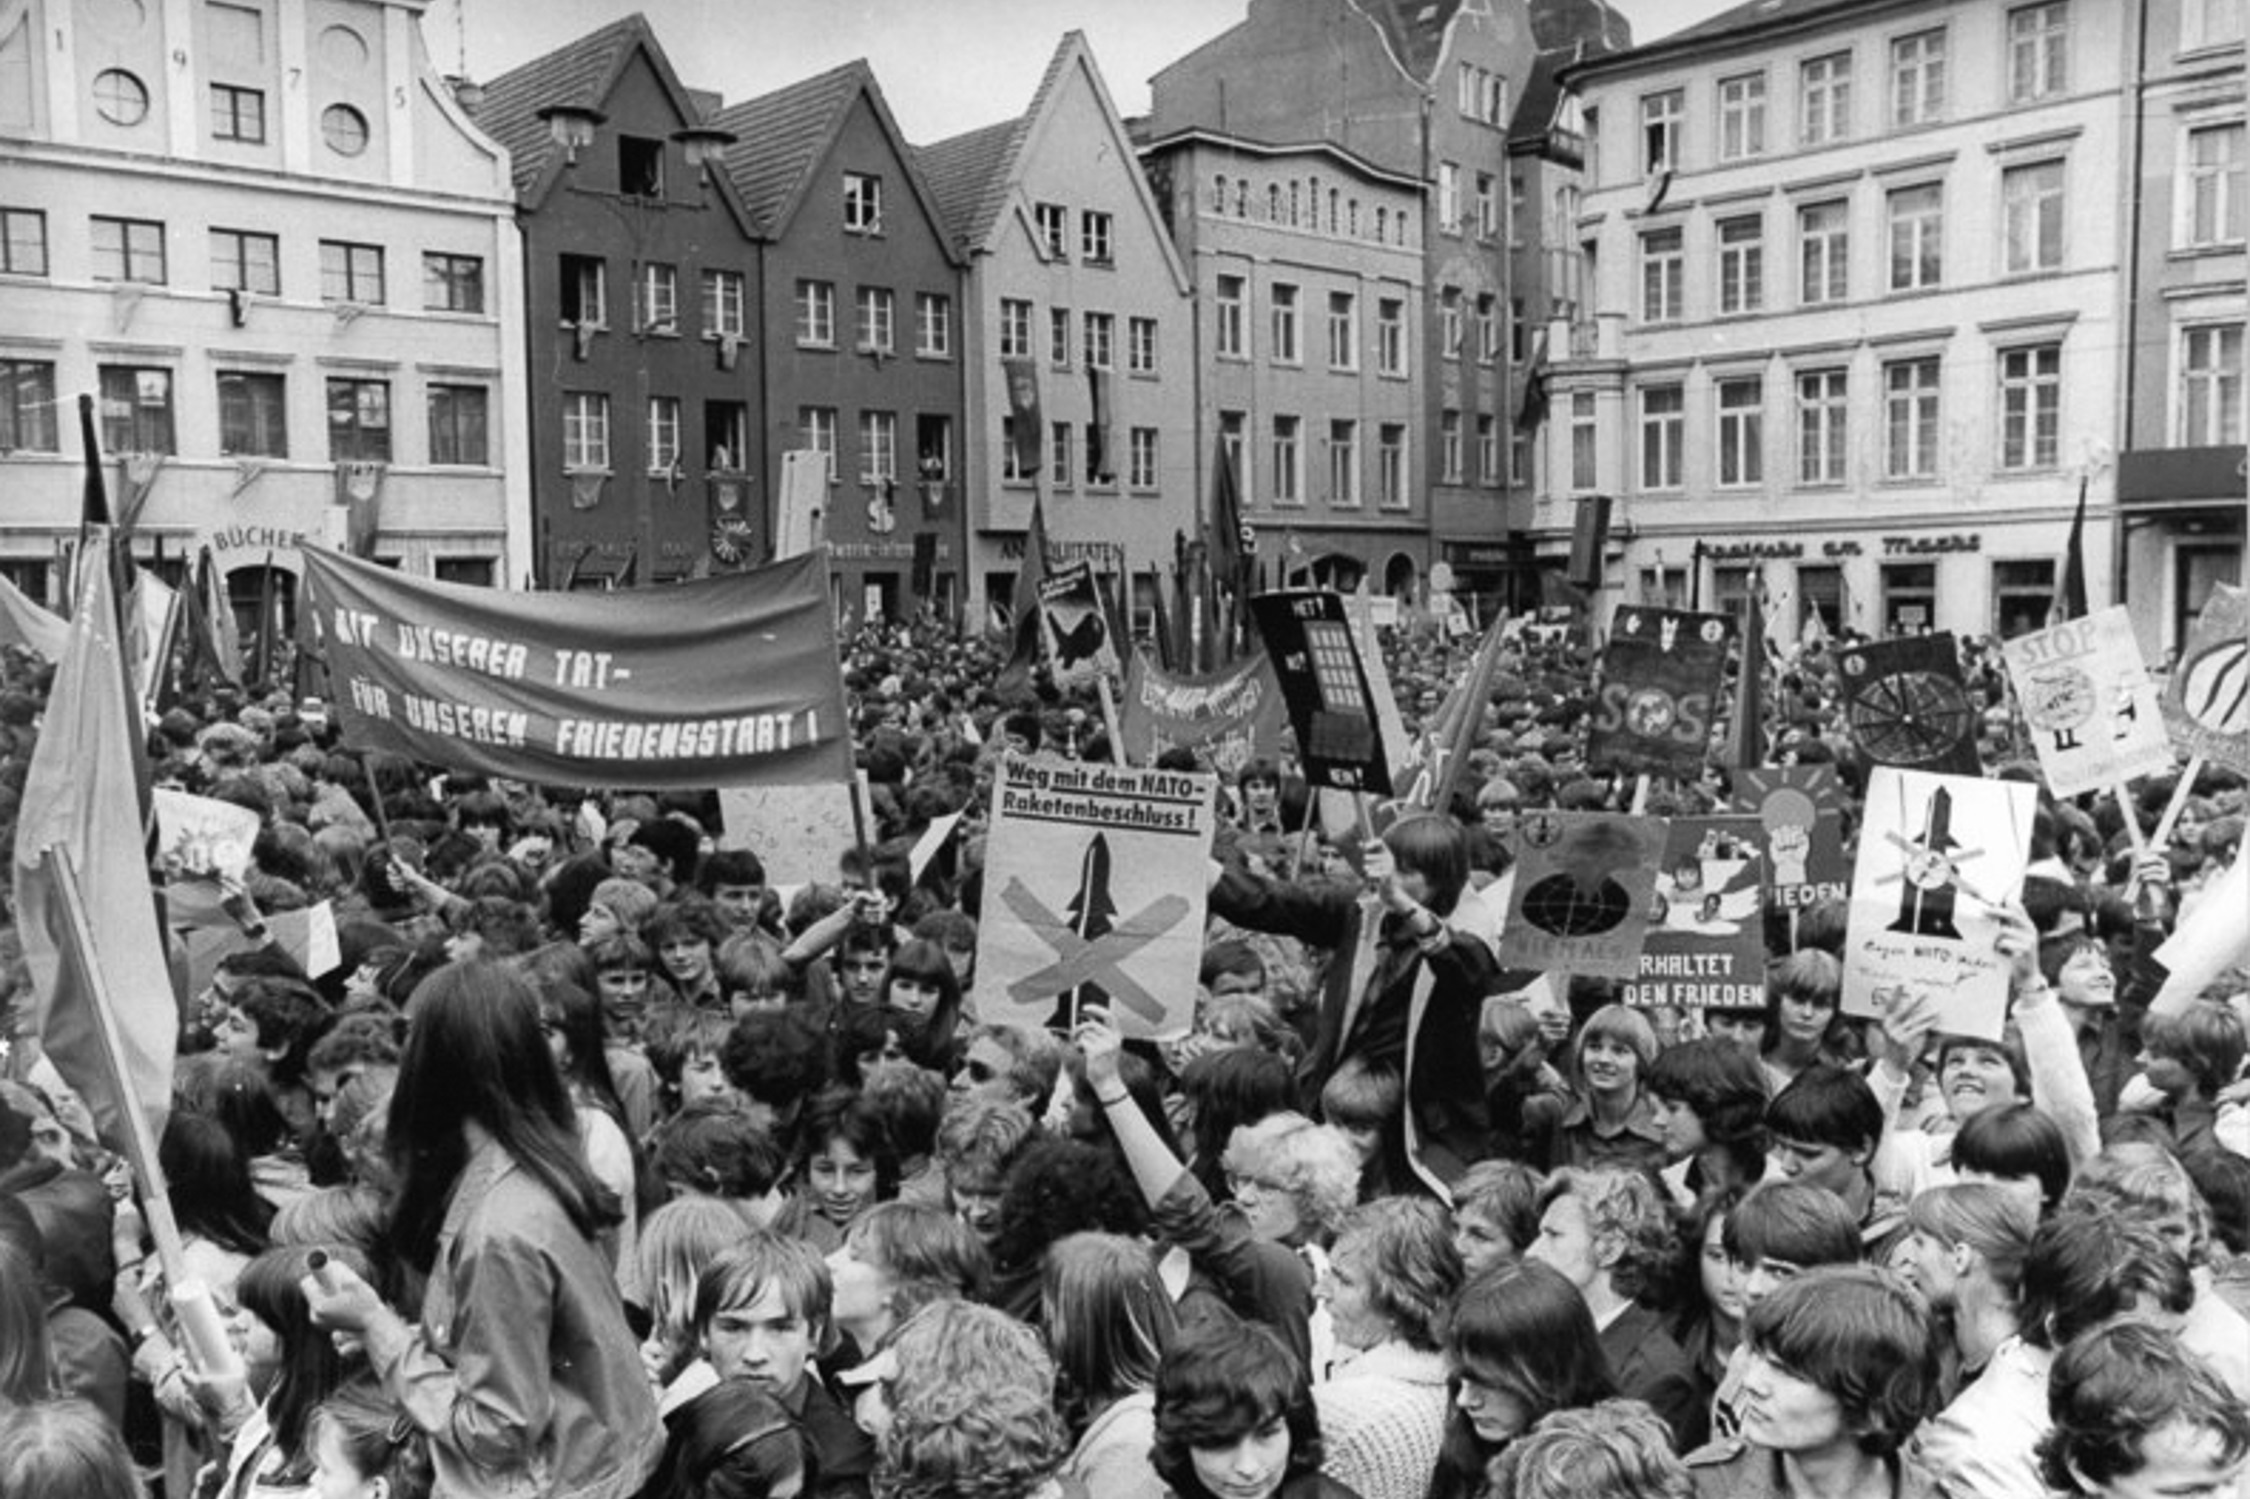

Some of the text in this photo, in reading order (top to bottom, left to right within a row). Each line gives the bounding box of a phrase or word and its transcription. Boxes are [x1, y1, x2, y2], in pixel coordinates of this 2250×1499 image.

[397, 622, 529, 680] UNSERER
[2020, 618, 2099, 666] STOP
[351, 674, 392, 720] FÜR
[403, 693, 528, 747] UNSEREN
[555, 712, 794, 760] FRIEDENSSTAAT
[1594, 682, 1710, 744] SOS
[1006, 761, 1206, 798] Weg mit dem NATO-
[1774, 881, 1847, 908] IEDEN
[1639, 952, 1734, 978] RHALTET
[1624, 984, 1766, 1008] DEN FRIEDEN
